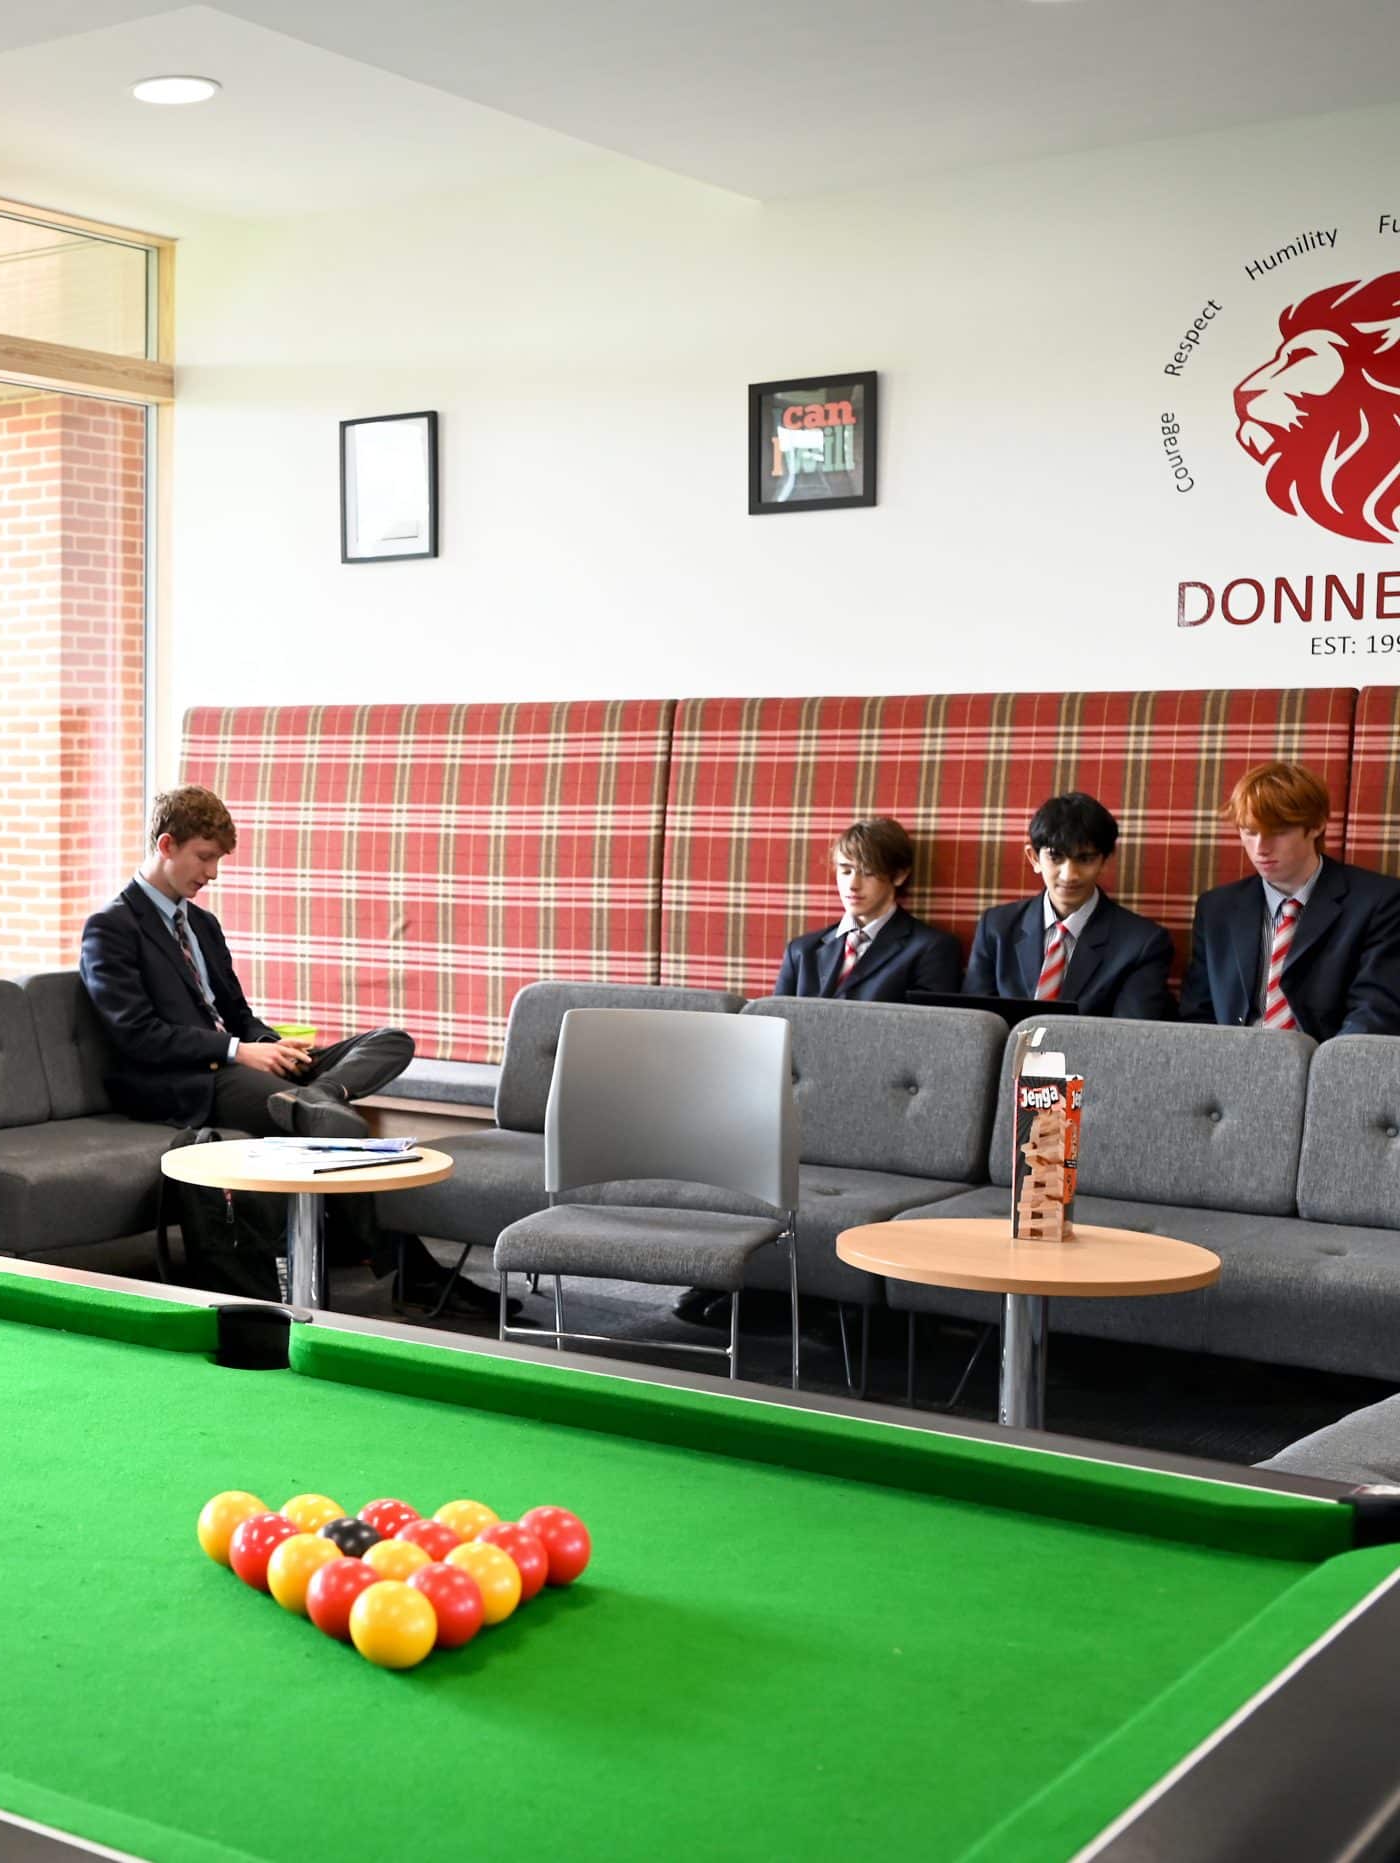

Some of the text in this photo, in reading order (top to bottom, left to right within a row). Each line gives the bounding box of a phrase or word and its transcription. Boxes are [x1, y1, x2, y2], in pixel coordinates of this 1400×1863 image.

[1244, 227, 1338, 281] Humility
[1163, 298, 1223, 377] Respect
[782, 400, 857, 430] can
[1160, 411, 1195, 493] Courage
[1176, 570, 1400, 628] DONNE
[1310, 633, 1400, 656] EST: 19
[1020, 1085, 1059, 1109] Jenga
